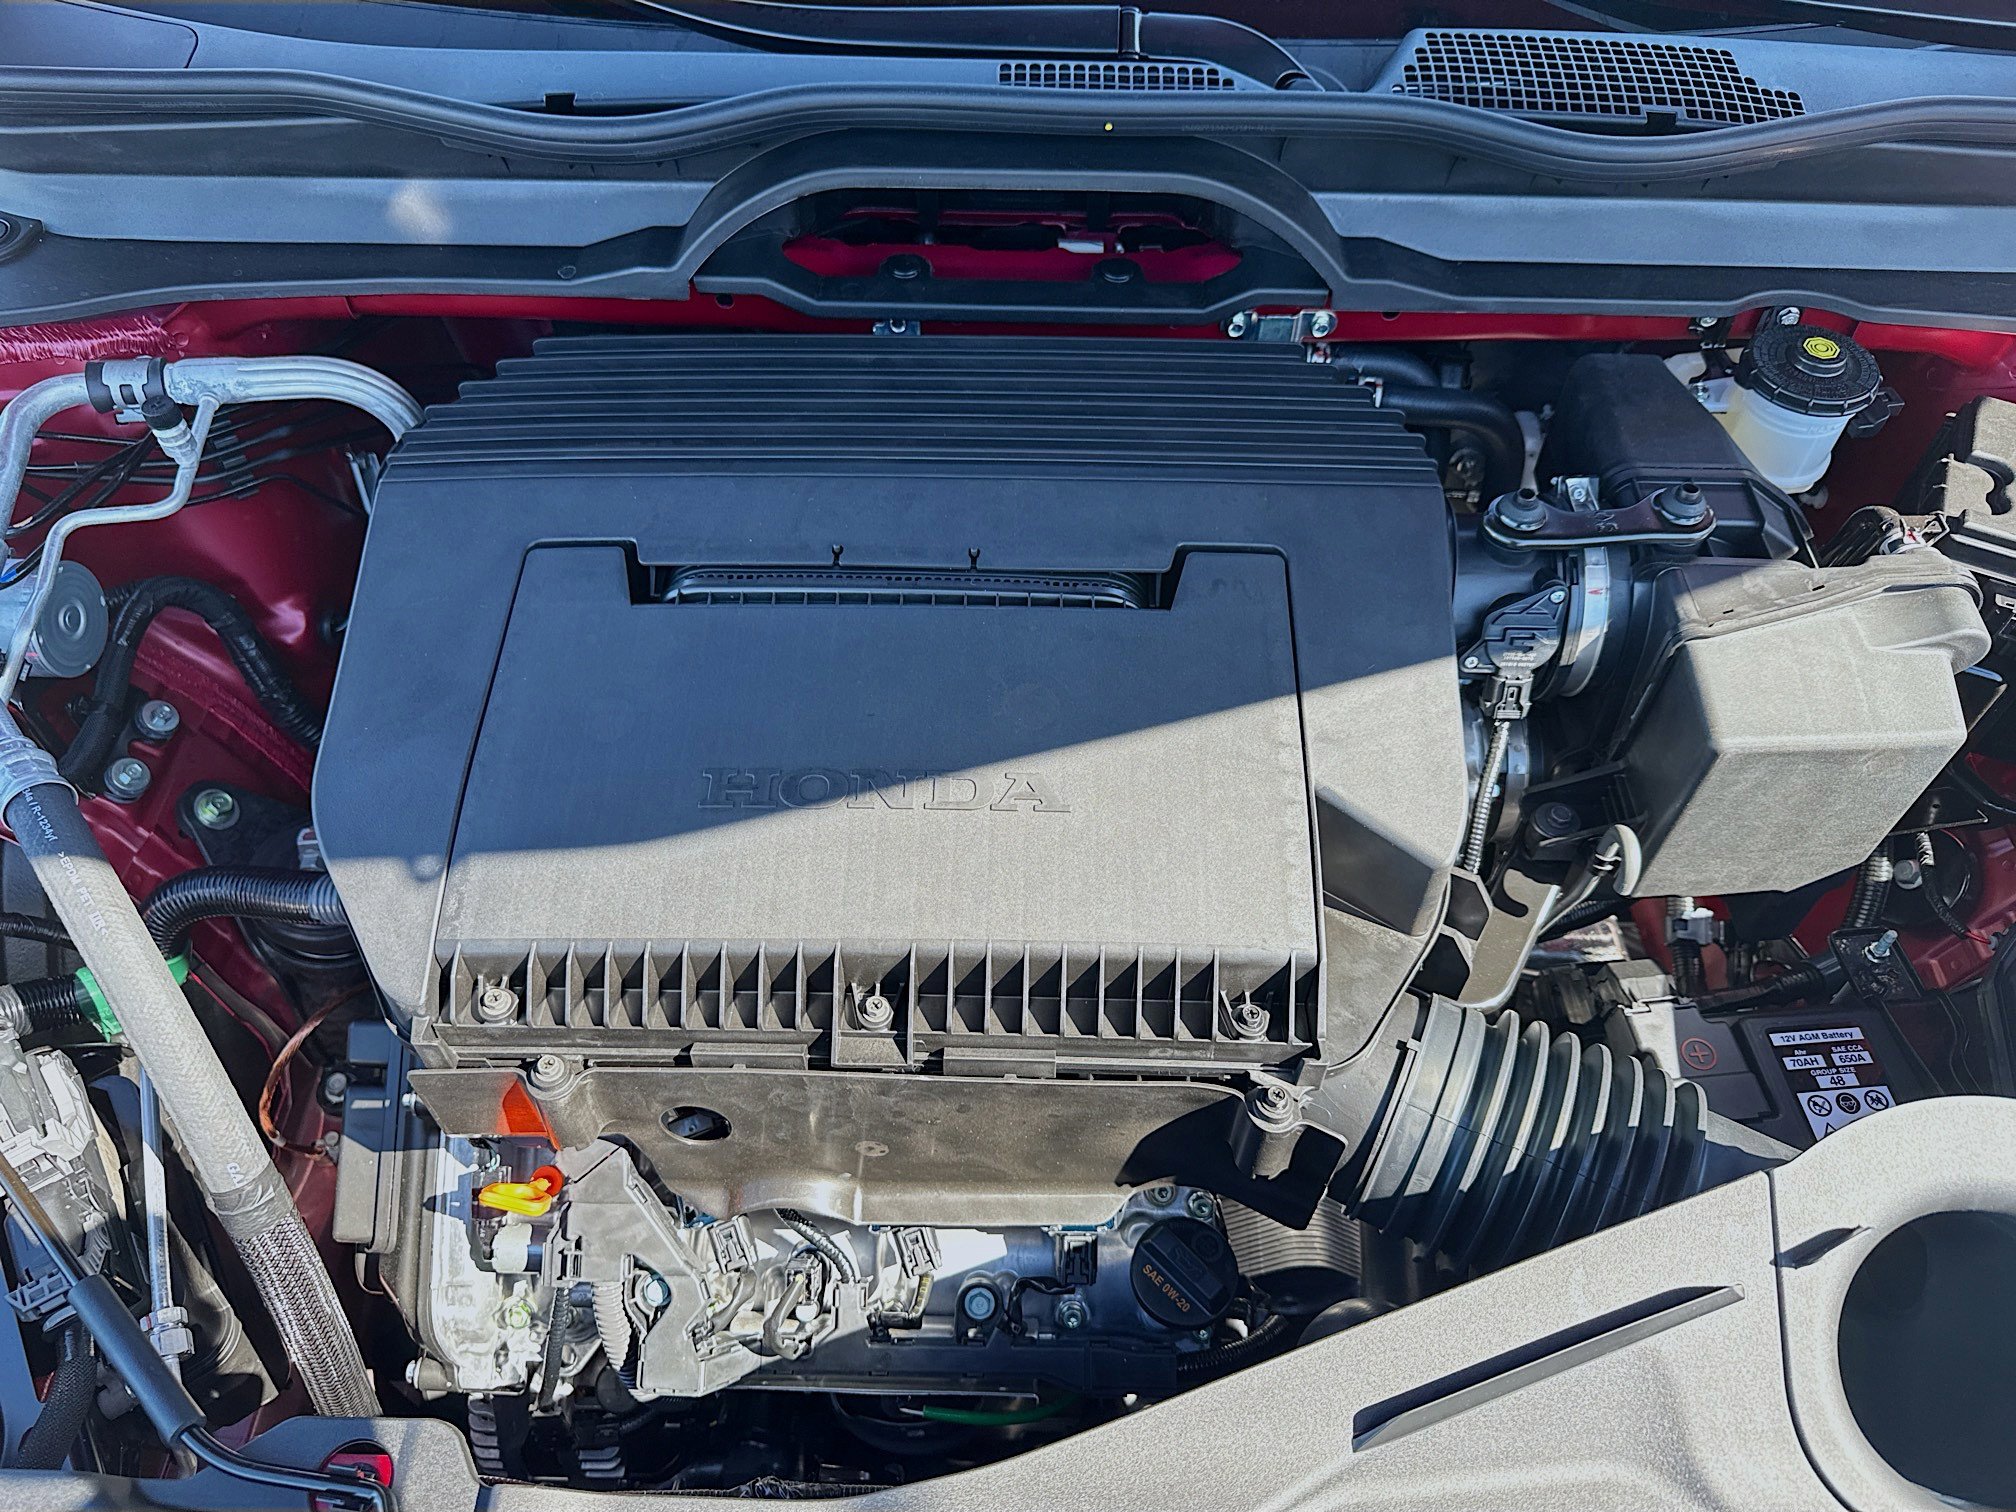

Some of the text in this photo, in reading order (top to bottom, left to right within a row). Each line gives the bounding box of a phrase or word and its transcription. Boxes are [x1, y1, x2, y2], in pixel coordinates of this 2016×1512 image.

[697, 768, 1072, 813] HONDA
[32, 806, 59, 842] R-1234yf
[1799, 1033, 1821, 1042] AGM
[1822, 1031, 1854, 1041] Battery
[1790, 1057, 1819, 1068] 70AH
[1838, 1054, 1866, 1064] 650A
[1810, 1068, 1838, 1076] GROUP
[1829, 1076, 1846, 1086] 48
[1142, 1264, 1191, 1313] SAE 0W-20
